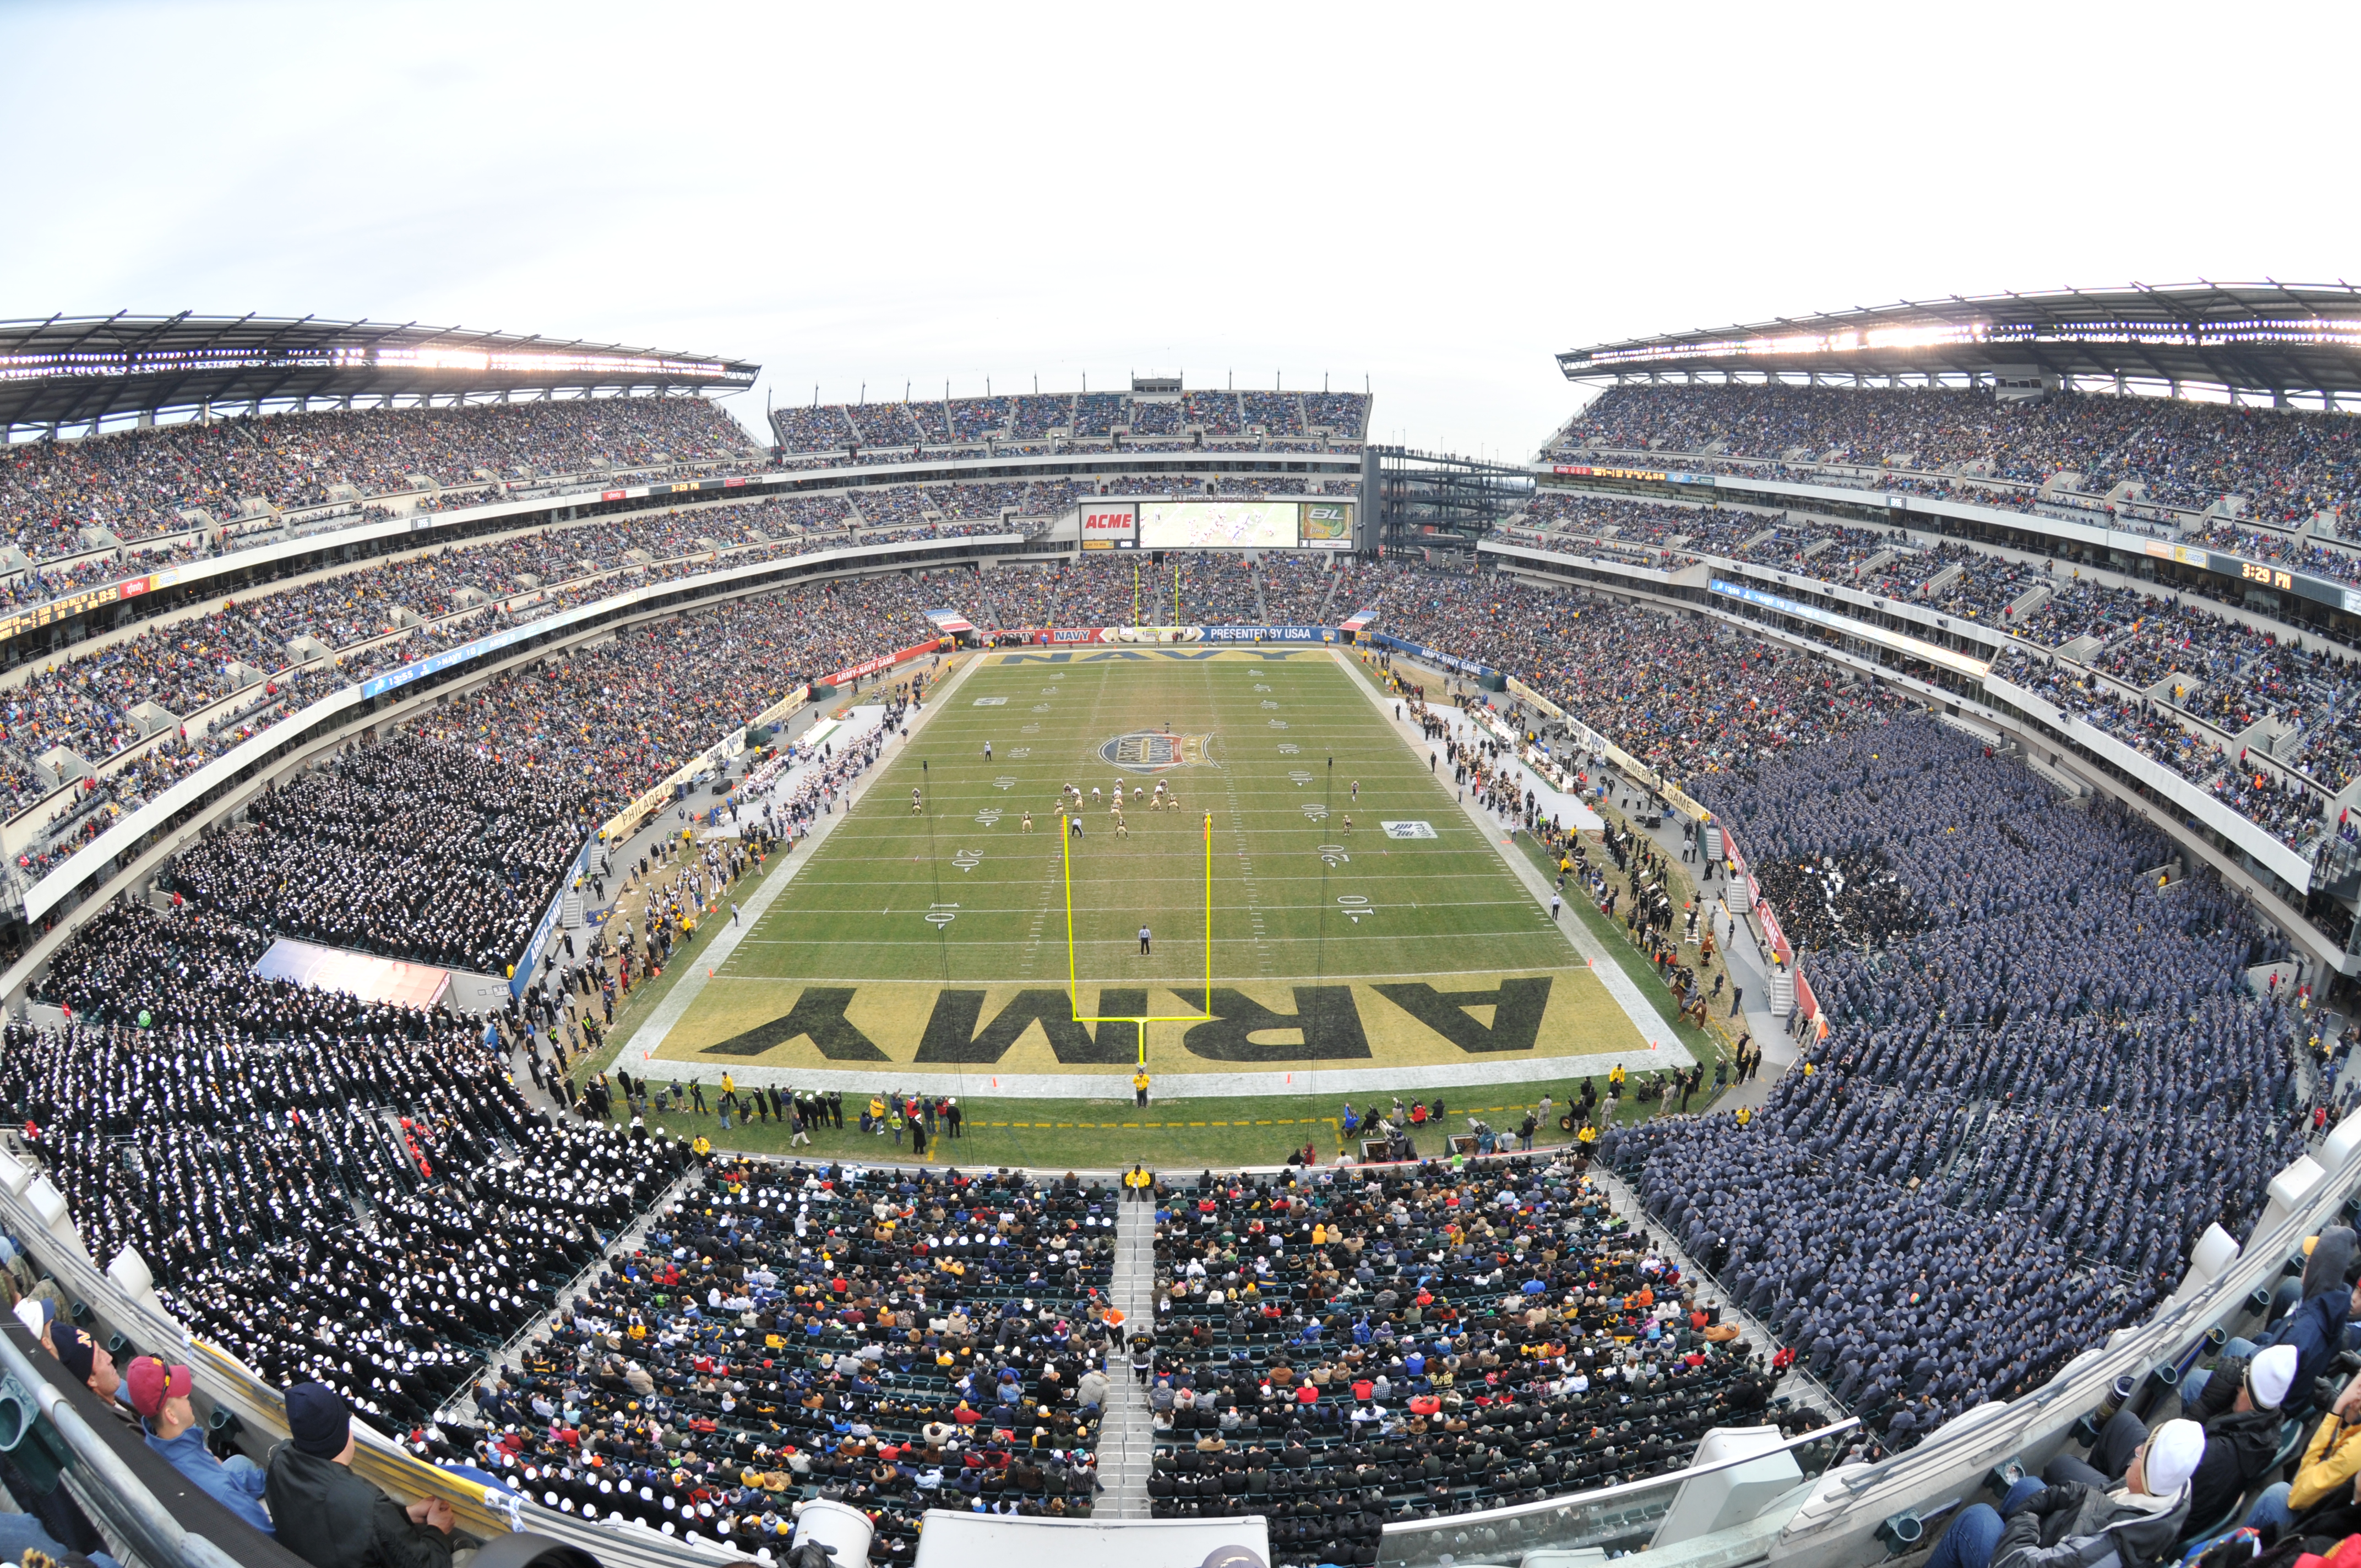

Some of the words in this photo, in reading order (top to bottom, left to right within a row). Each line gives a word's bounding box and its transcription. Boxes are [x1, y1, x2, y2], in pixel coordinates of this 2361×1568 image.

[671, 483, 688, 492] 3:29
[1085, 514, 1132, 529] ACME
[1309, 508, 1343, 520] BL
[2185, 549, 2205, 564] Snapple
[2242, 563, 2271, 584] 3:29
[2275, 571, 2292, 589] PM
[127, 581, 144, 595] xfinity
[39, 606, 51, 617] DOWN
[54, 603, 61, 611] TO
[68, 597, 81, 607] BALL
[99, 587, 117, 603] 13:55
[1759, 595, 1774, 605] NAVY
[1796, 606, 1813, 618] ARMY
[12, 616, 20, 626] 10
[39, 615, 50, 625] 1ST
[57, 610, 66, 619] 10
[1054, 629, 1090, 641] NAVY
[1211, 628, 1267, 639] PRESENTED
[1271, 628, 1283, 639] BY
[1285, 628, 1311, 639] USAA
[388, 670, 414, 685] 13:55
[442, 652, 463, 666] NAVY
[466, 647, 476, 657] 10
[489, 635, 508, 649] ARMY
[510, 633, 515, 641] 0
[1000, 650, 1309, 665] NAVY
[1422, 649, 1459, 667] ARMY-NAVY
[1461, 661, 1481, 675] GAME
[836, 665, 876, 683] ARMY-NAVY
[878, 655, 896, 669] GAME
[1516, 684, 1553, 717] PHILADELPHIA
[759, 703, 785, 727] AMERICA'S
[786, 694, 799, 707] GAME
[1570, 720, 1586, 738] ARMY
[1590, 733, 1607, 752] NAVY
[706, 744, 722, 765] ARMY
[726, 731, 743, 749] NAVY
[1008, 747, 1031, 758] 50
[1277, 744, 1300, 754] 50
[992, 775, 1018, 787] 40
[1288, 771, 1313, 783] 40
[623, 774, 684, 826] PHILADELPHIA
[1668, 788, 1692, 813] GAME
[975, 808, 1003, 823] 30
[1301, 804, 1329, 818] 30
[951, 849, 984, 867] 20
[1317, 845, 1350, 862] 20
[1337, 895, 1375, 916] 10
[1728, 845, 1744, 875] ARMY
[1761, 908, 1779, 949] GAME
[530, 894, 563, 966] ARMY-NAVY
[568, 860, 583, 892] GAME
[924, 902, 960, 923] 10
[698, 976, 1553, 1064] ARMY
[76, 1329, 92, 1348] N
